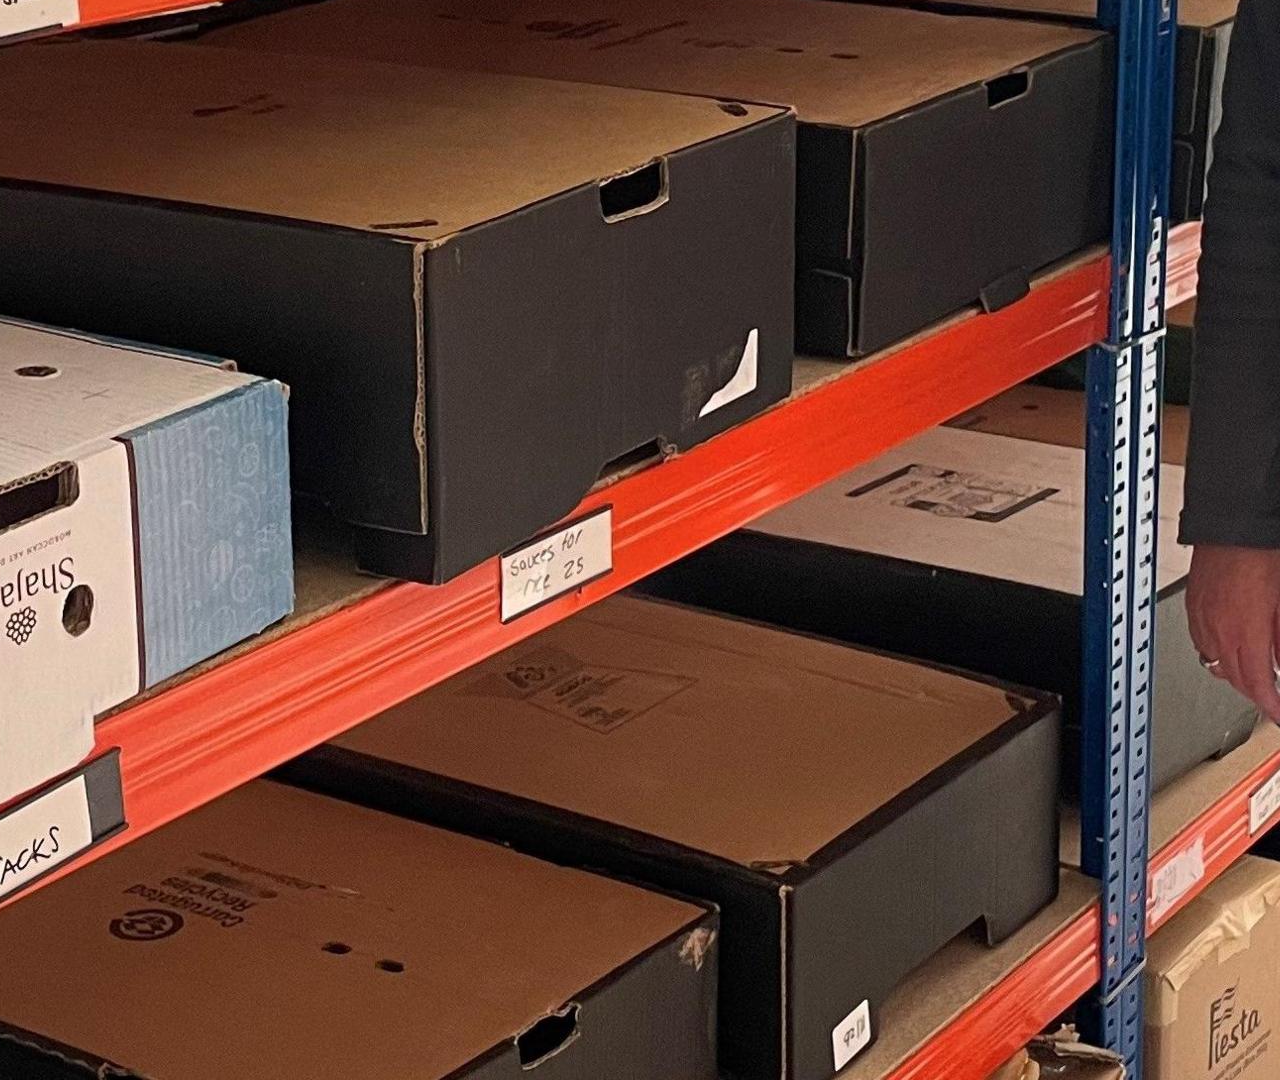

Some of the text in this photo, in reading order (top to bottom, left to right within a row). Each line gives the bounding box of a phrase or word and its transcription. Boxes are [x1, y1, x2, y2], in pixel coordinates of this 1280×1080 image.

[8, 551, 23, 563] ART
[27, 529, 71, 555] MOROCCAN
[122, 884, 245, 929] Corrugated
[159, 876, 259, 913] Recycles
[1208, 976, 1262, 1070] Fiesta
